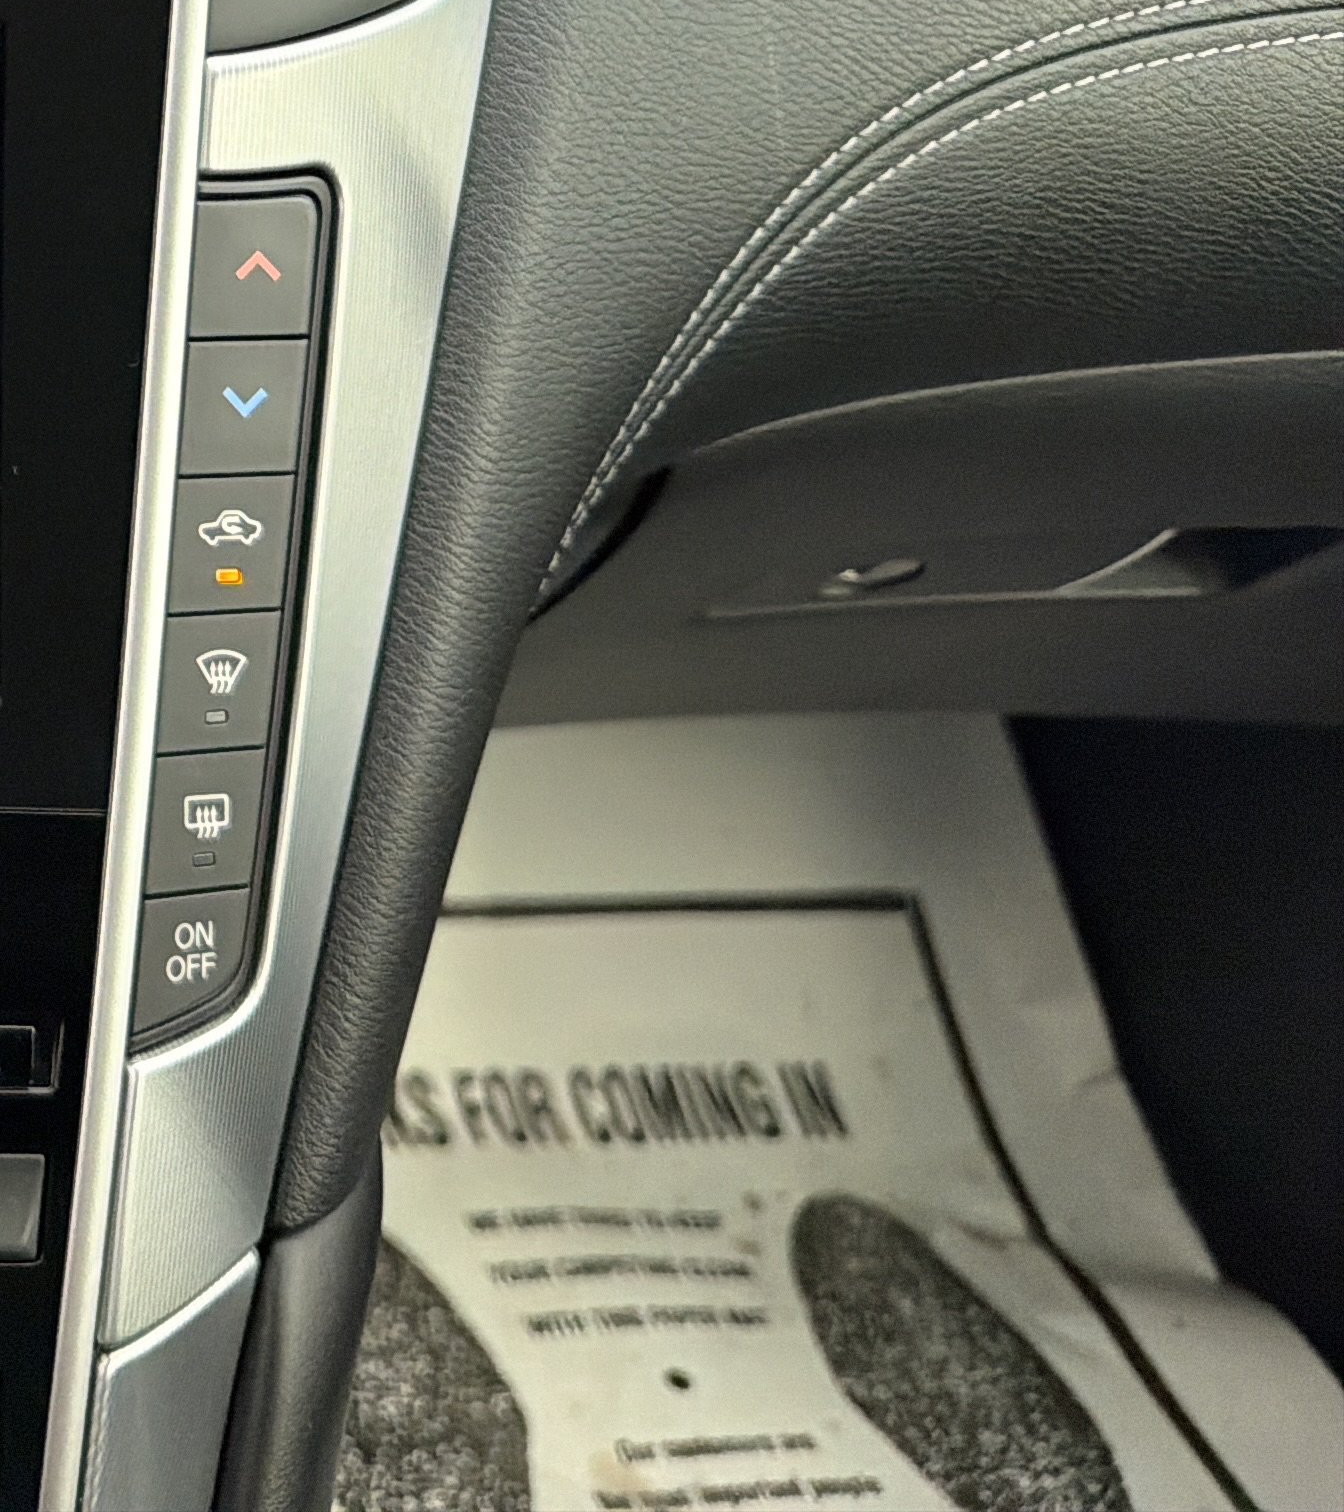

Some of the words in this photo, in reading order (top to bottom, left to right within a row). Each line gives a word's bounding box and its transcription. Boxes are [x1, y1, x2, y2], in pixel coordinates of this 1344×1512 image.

[174, 921, 215, 950] ON
[166, 954, 217, 983] OFF
[451, 1065, 564, 1146] FOR
[568, 1060, 780, 1144] COMING
